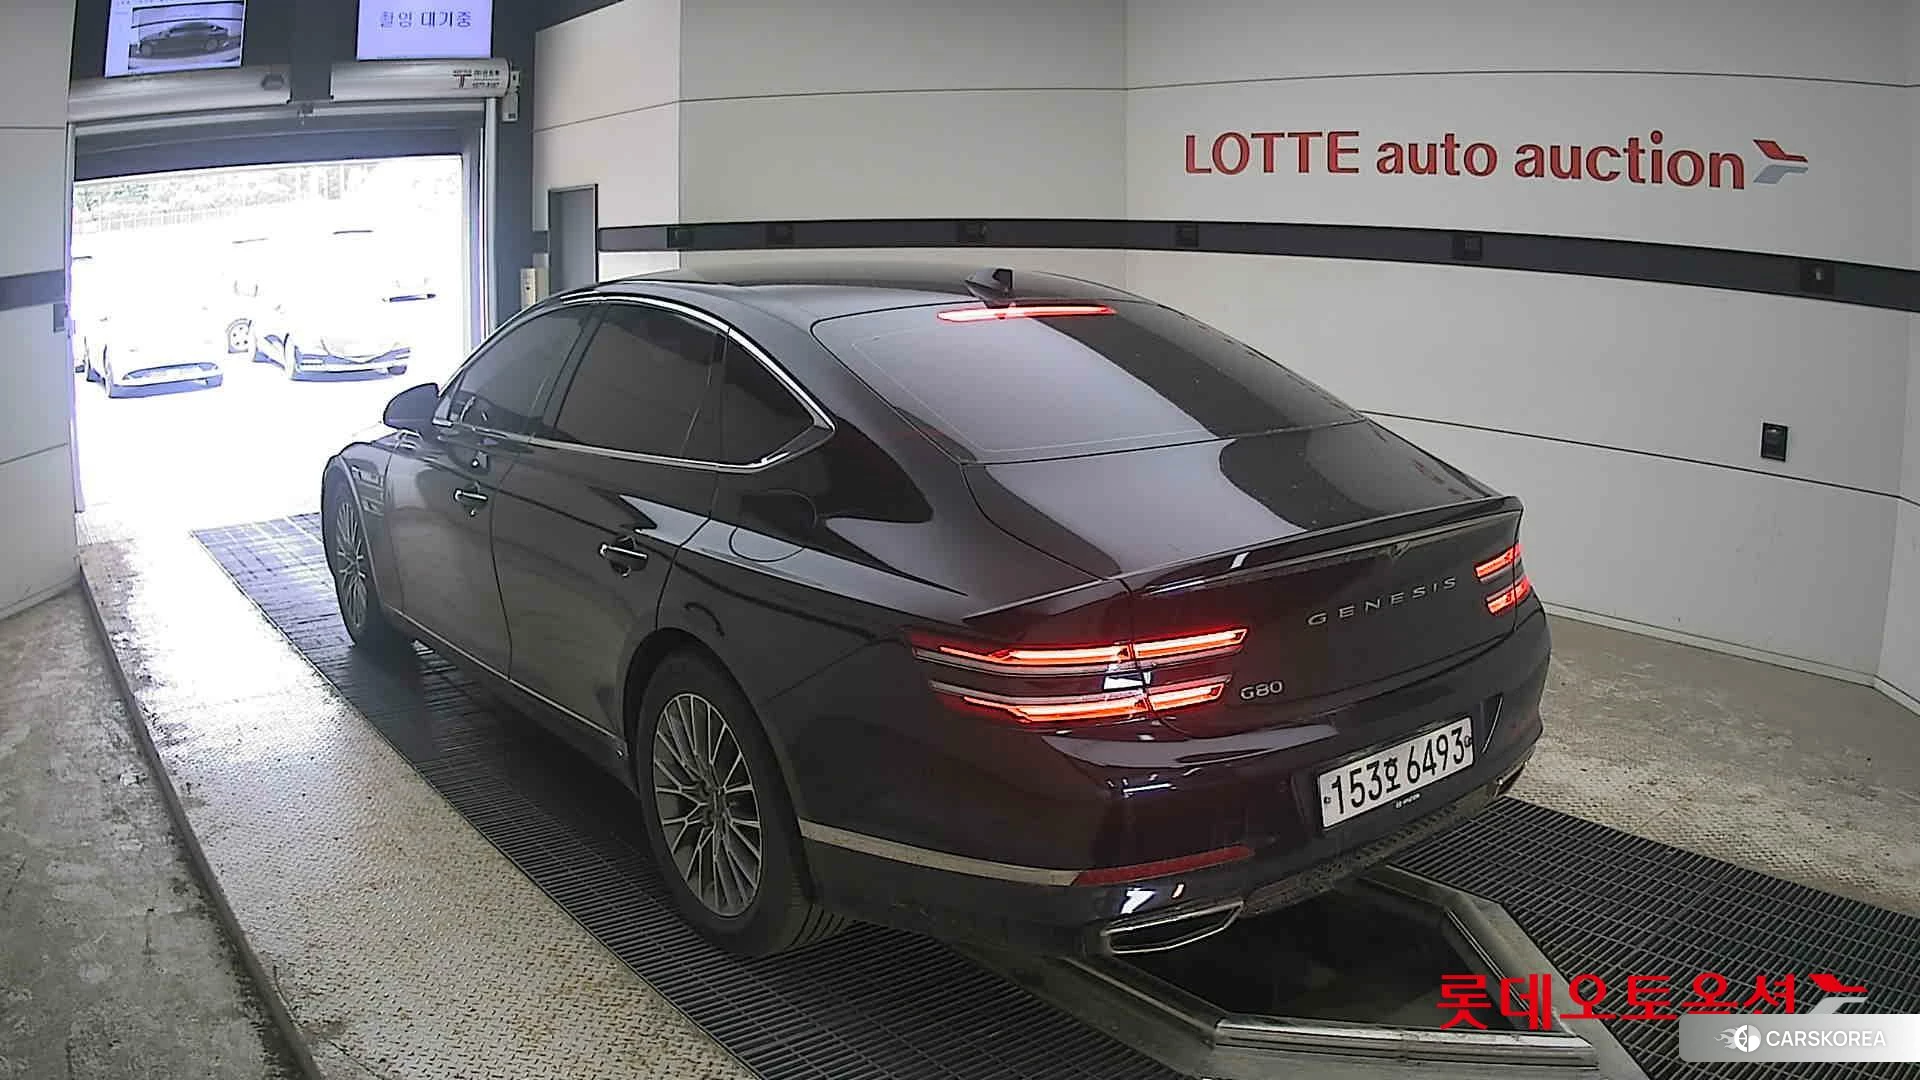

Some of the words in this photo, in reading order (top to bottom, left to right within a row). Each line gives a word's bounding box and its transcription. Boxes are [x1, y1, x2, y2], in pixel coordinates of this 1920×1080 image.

[421, 10, 471, 28] 대기중
[1185, 131, 1360, 175] LOTTE
[1376, 133, 1498, 177] auto
[1514, 130, 1745, 189] auction
[1308, 576, 1457, 626] GENESIS
[1241, 680, 1283, 700] G80
[1407, 727, 1465, 784] 6493
